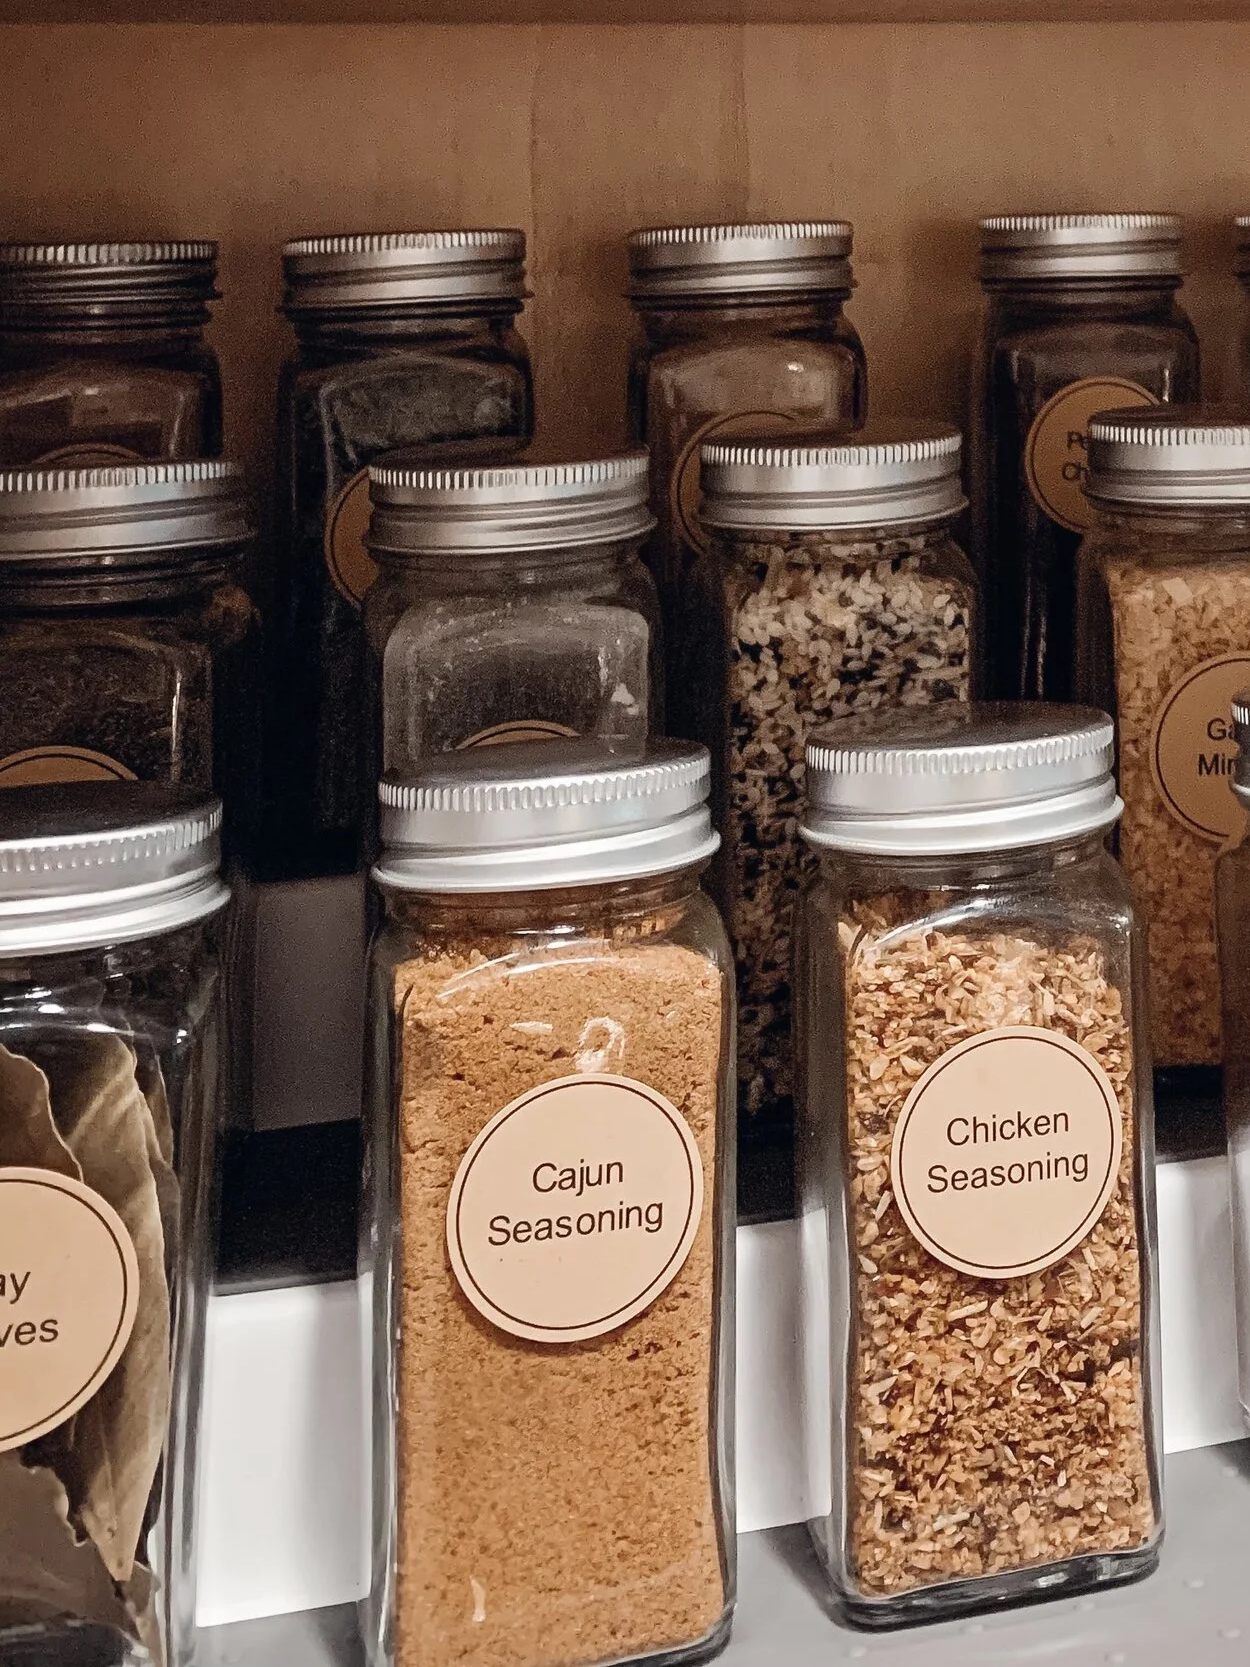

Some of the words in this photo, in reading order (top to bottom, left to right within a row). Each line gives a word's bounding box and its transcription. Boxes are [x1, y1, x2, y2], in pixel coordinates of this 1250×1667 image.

[946, 1110, 1069, 1146] Chicken
[532, 1158, 624, 1197] Cajun
[927, 1151, 1089, 1193] Seasoning
[488, 1200, 664, 1246] Seasoning
